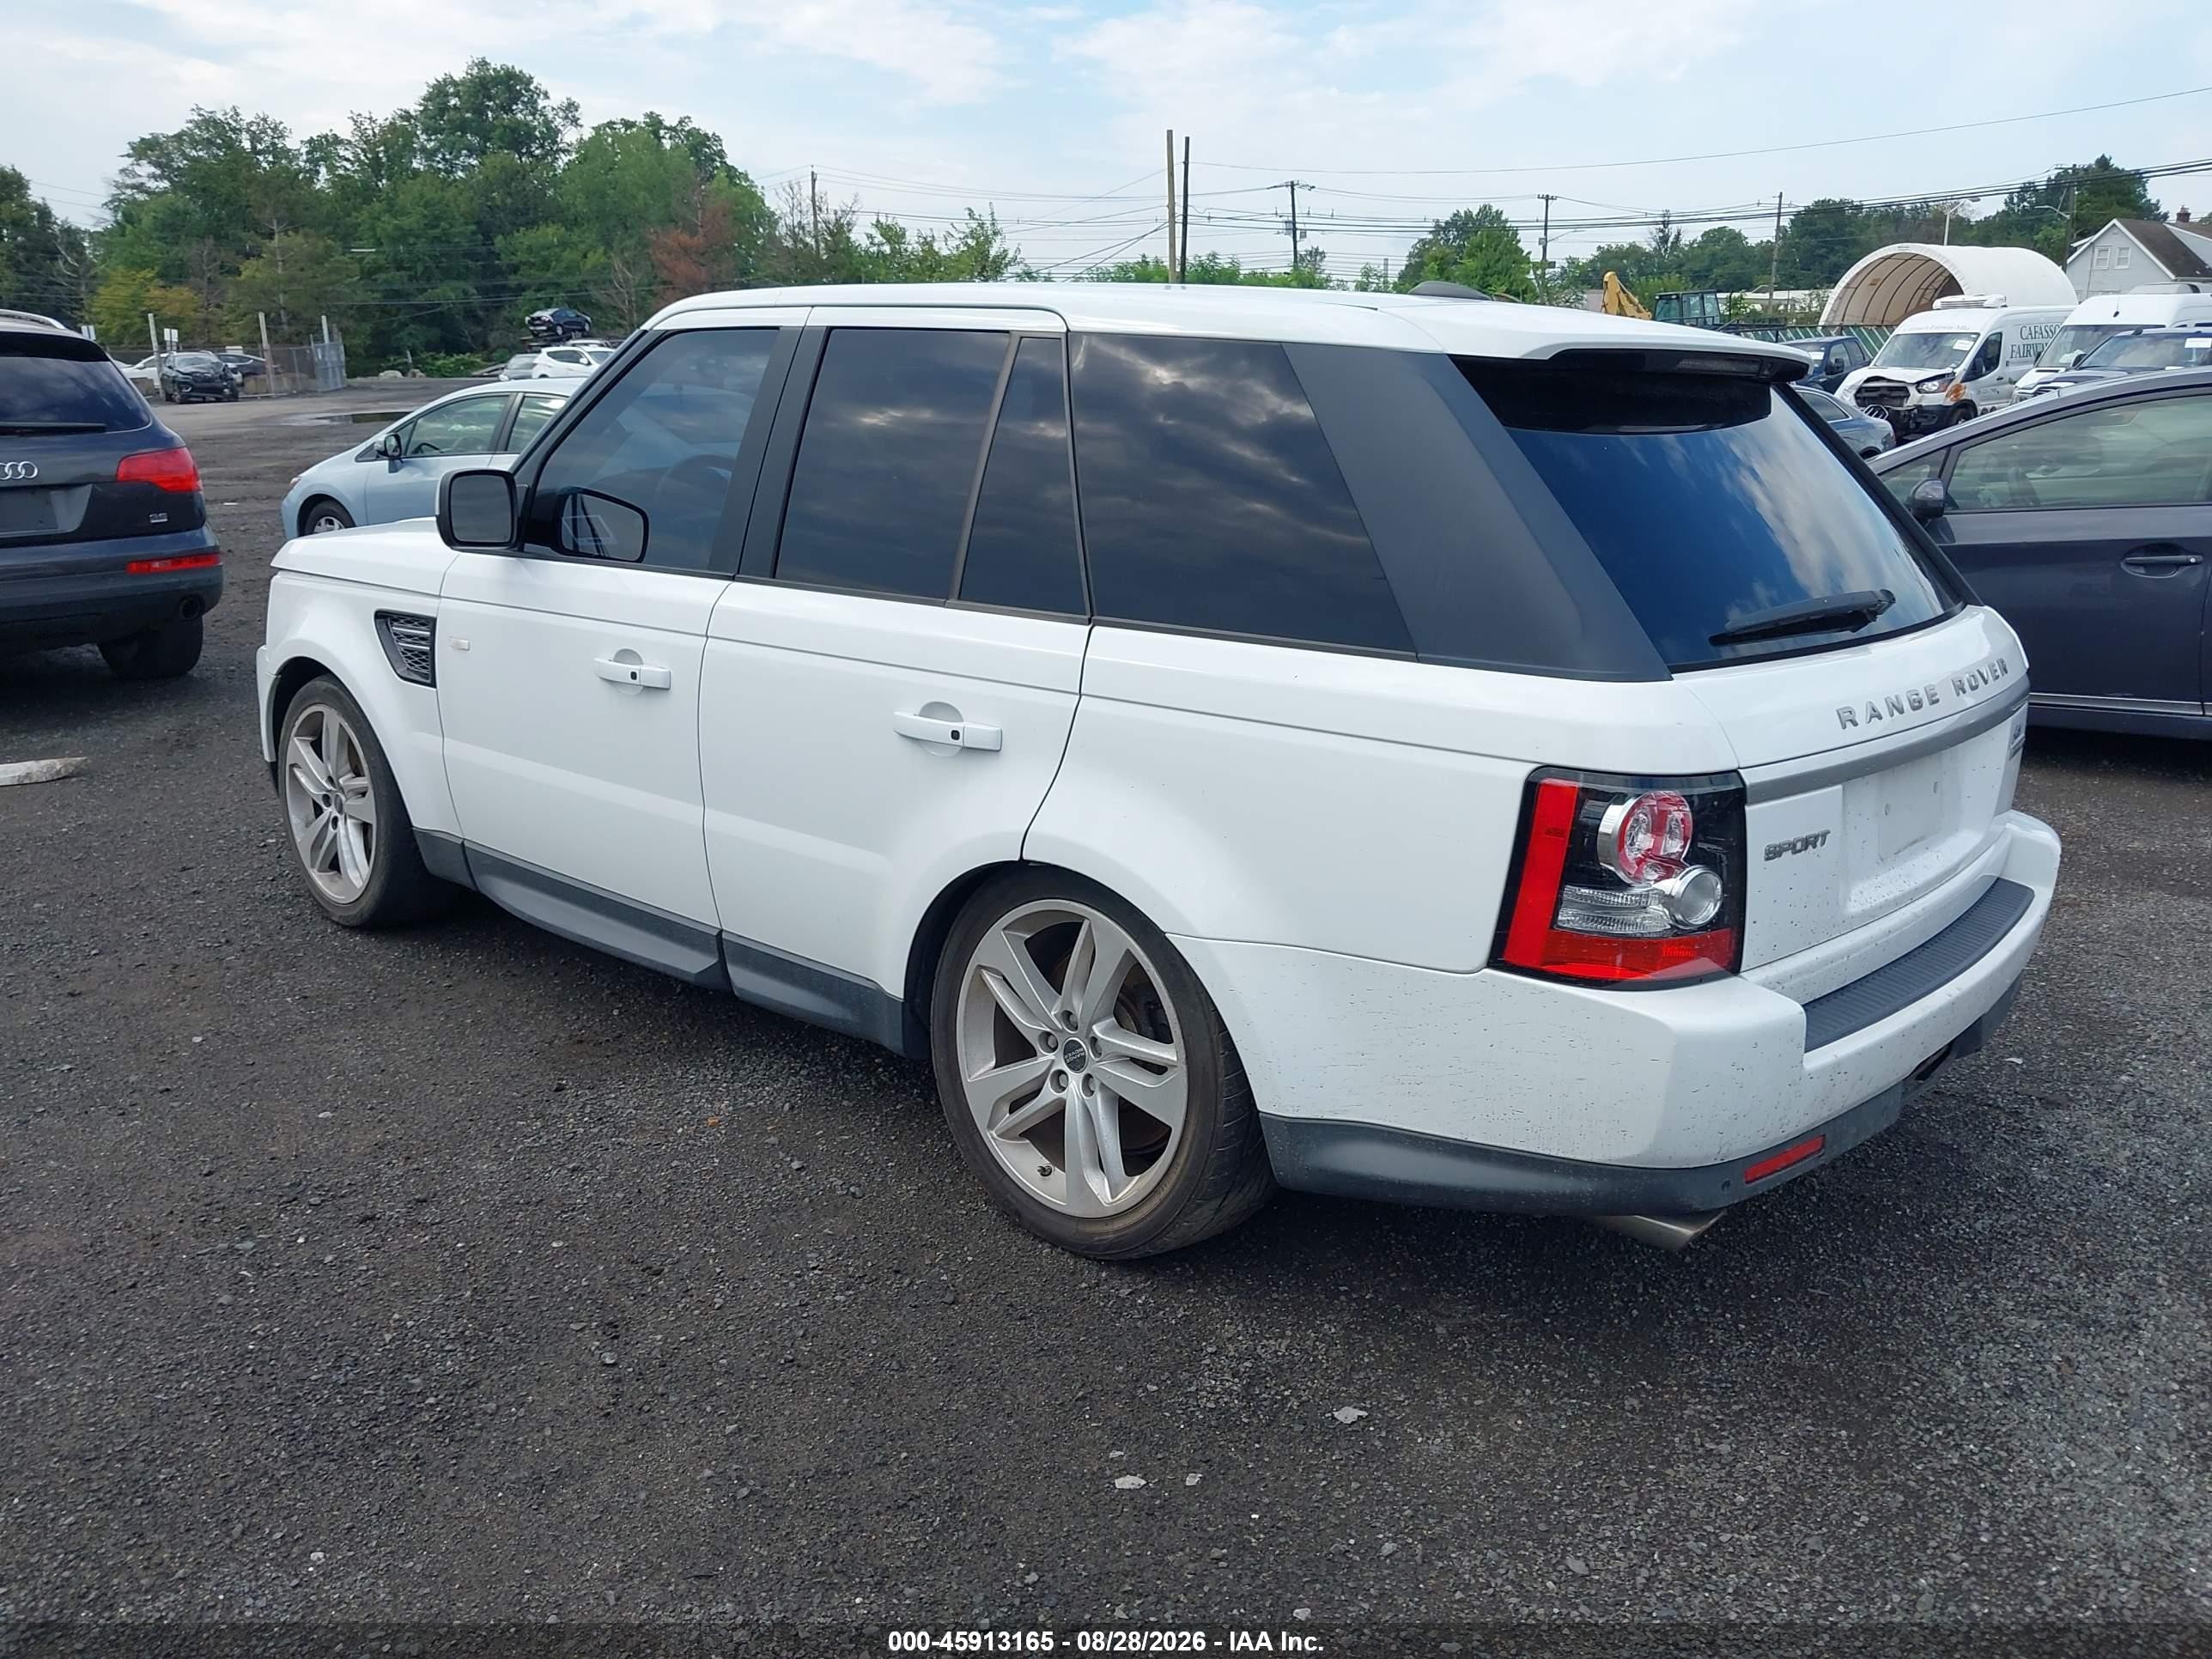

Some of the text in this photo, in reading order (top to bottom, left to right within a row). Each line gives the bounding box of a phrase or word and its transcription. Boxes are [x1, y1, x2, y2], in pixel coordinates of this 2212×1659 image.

[1835, 657, 2009, 730] RANGE ROVER
[1764, 829, 1831, 861] SPORT
